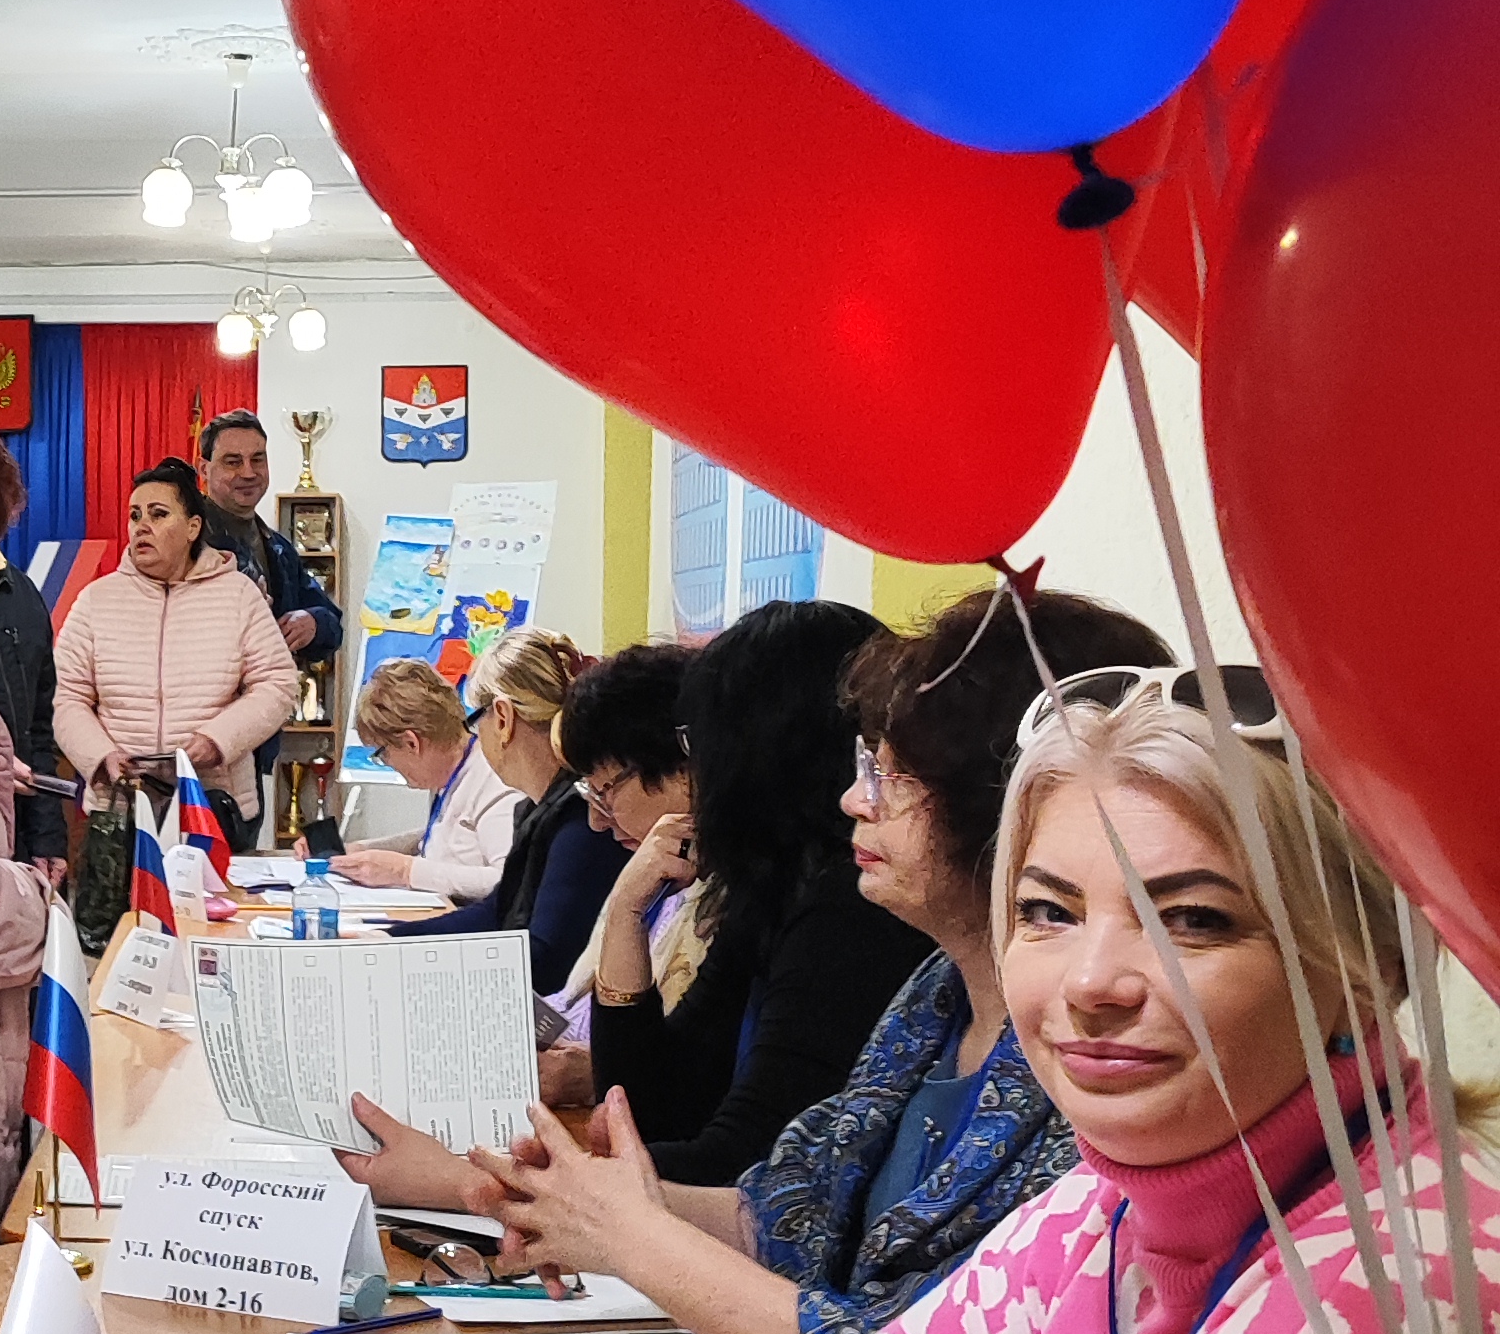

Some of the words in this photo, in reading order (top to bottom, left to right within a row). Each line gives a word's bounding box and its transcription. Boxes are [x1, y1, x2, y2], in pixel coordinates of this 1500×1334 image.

[158, 1170, 192, 1189] ул.
[201, 1171, 328, 1202] Форосский
[199, 1208, 263, 1232] спуск
[119, 1239, 154, 1260] ул.
[160, 1239, 320, 1285] Космонавтов,
[164, 1284, 208, 1306] дом
[215, 1287, 264, 1315] 2-16
